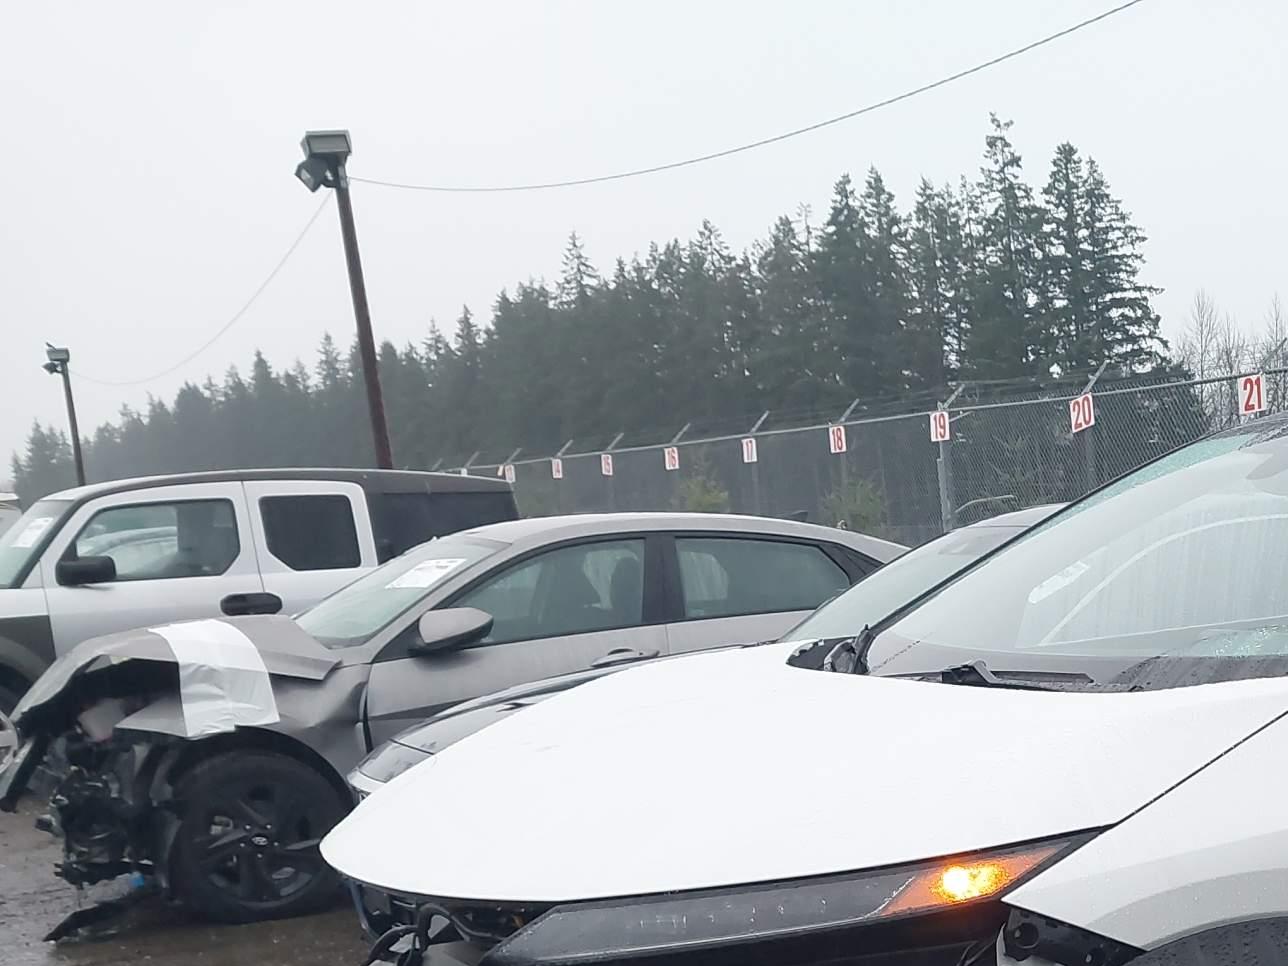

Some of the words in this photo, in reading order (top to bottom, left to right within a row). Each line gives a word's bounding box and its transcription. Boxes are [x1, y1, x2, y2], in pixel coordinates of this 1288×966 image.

[1243, 375, 1262, 411] 21
[1072, 395, 1092, 431] 20
[933, 413, 947, 439] 19
[744, 440, 754, 461] 17
[832, 427, 844, 452] 18
[667, 448, 677, 468] 16
